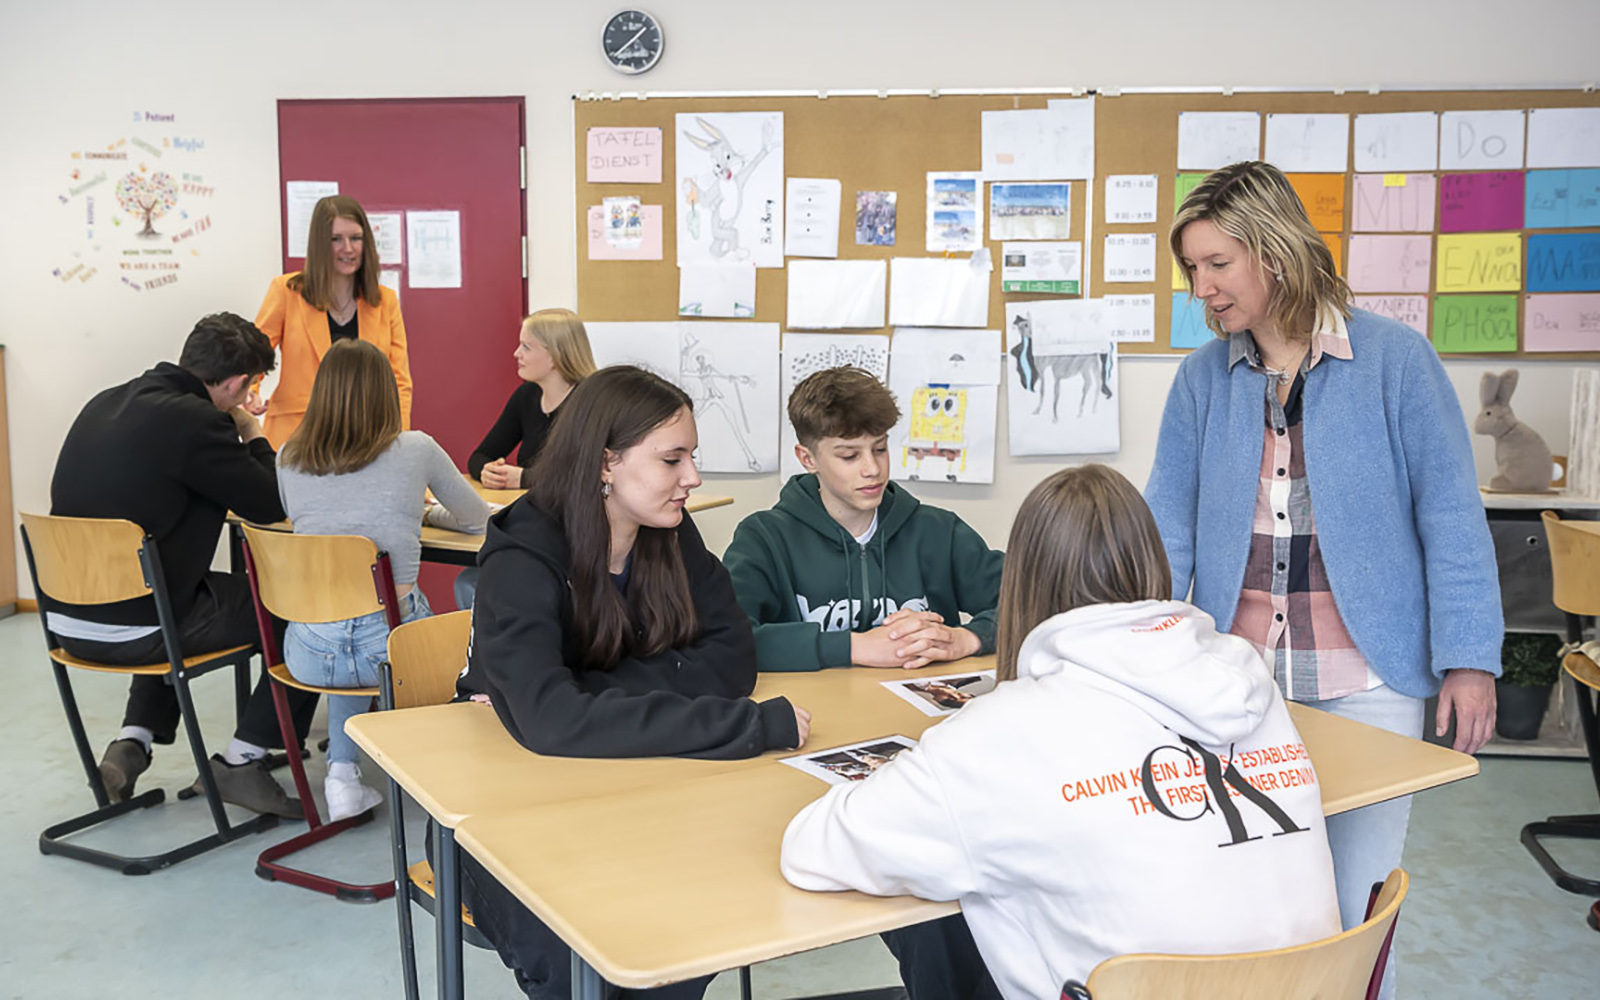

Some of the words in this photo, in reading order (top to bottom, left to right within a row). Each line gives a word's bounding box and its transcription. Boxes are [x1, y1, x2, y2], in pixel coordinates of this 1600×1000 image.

[589, 153, 653, 169] DIENST
[1061, 771, 1127, 803] CALVIN
[1129, 761, 1179, 788] KEIN
[1184, 754, 1230, 778] JES
[1127, 790, 1161, 816] TH
[1166, 784, 1209, 807] FIRST
[1279, 767, 1315, 789] DENIM
